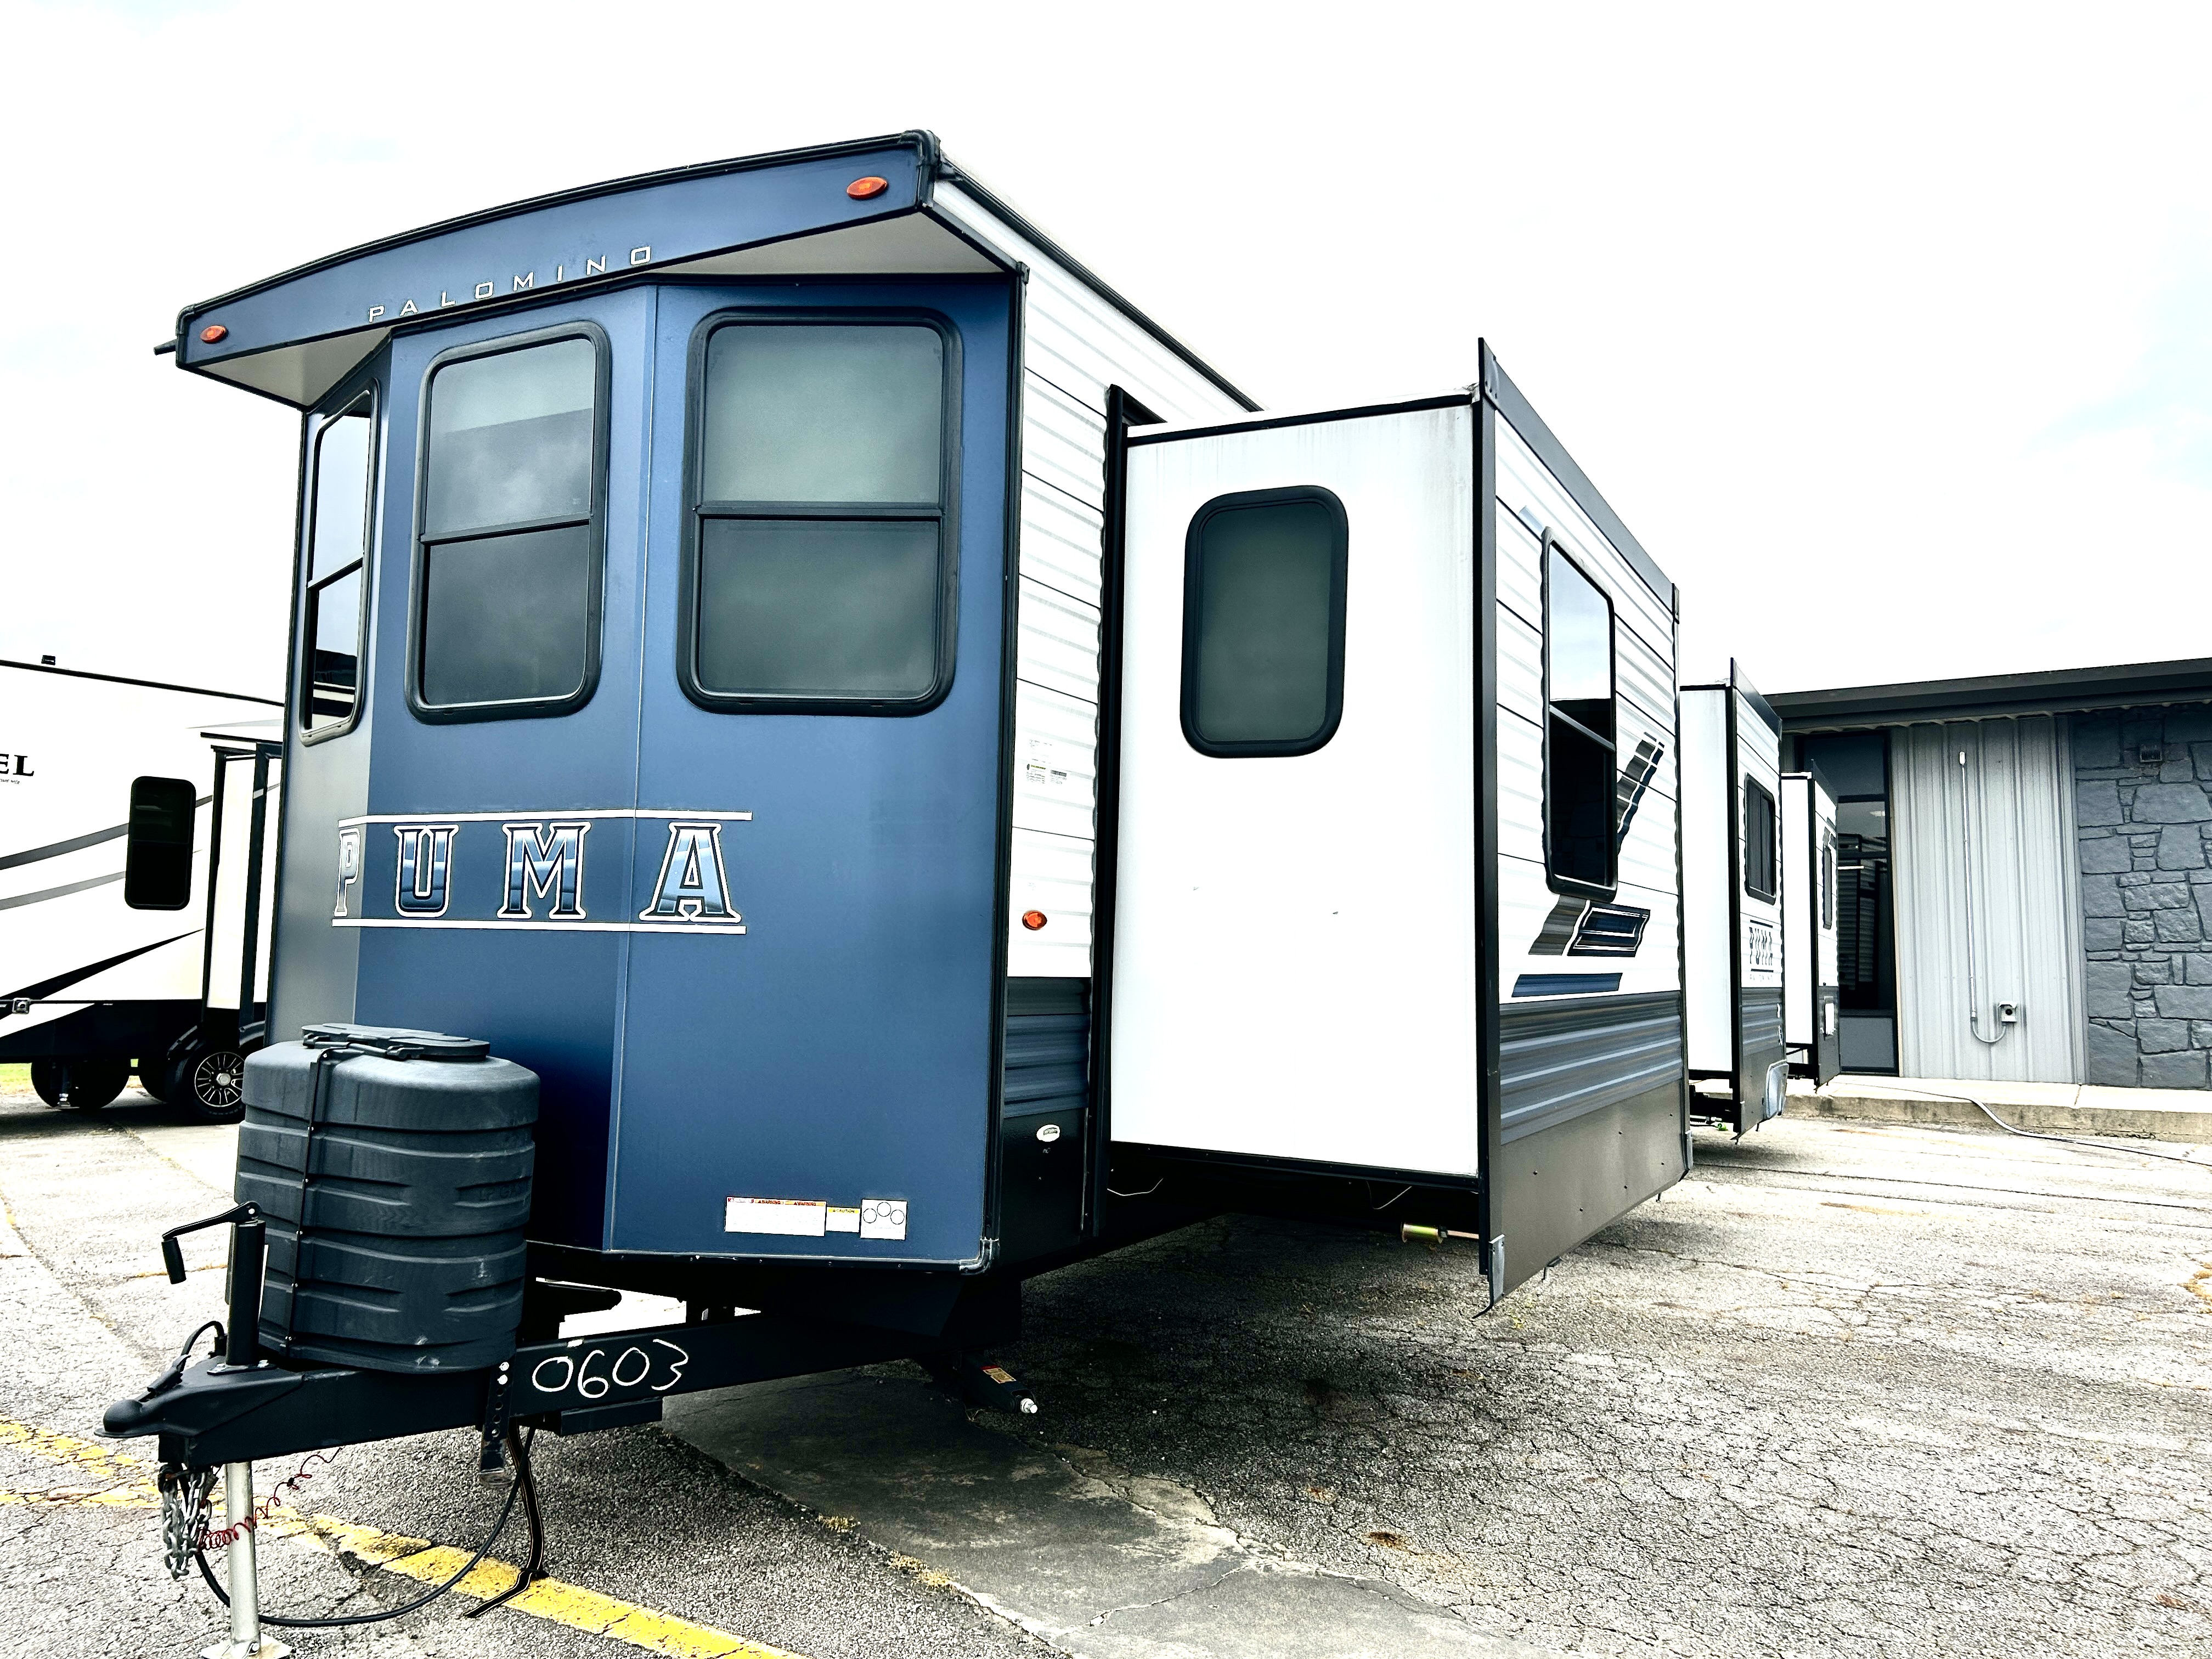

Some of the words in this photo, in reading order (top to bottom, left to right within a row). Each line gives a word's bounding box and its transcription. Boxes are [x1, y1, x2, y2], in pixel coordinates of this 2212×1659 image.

[369, 245, 652, 323] PALOMINO
[334, 821, 742, 923] PUMA
[1749, 926, 1774, 966] PUMA
[532, 1338, 689, 1399] 0603
